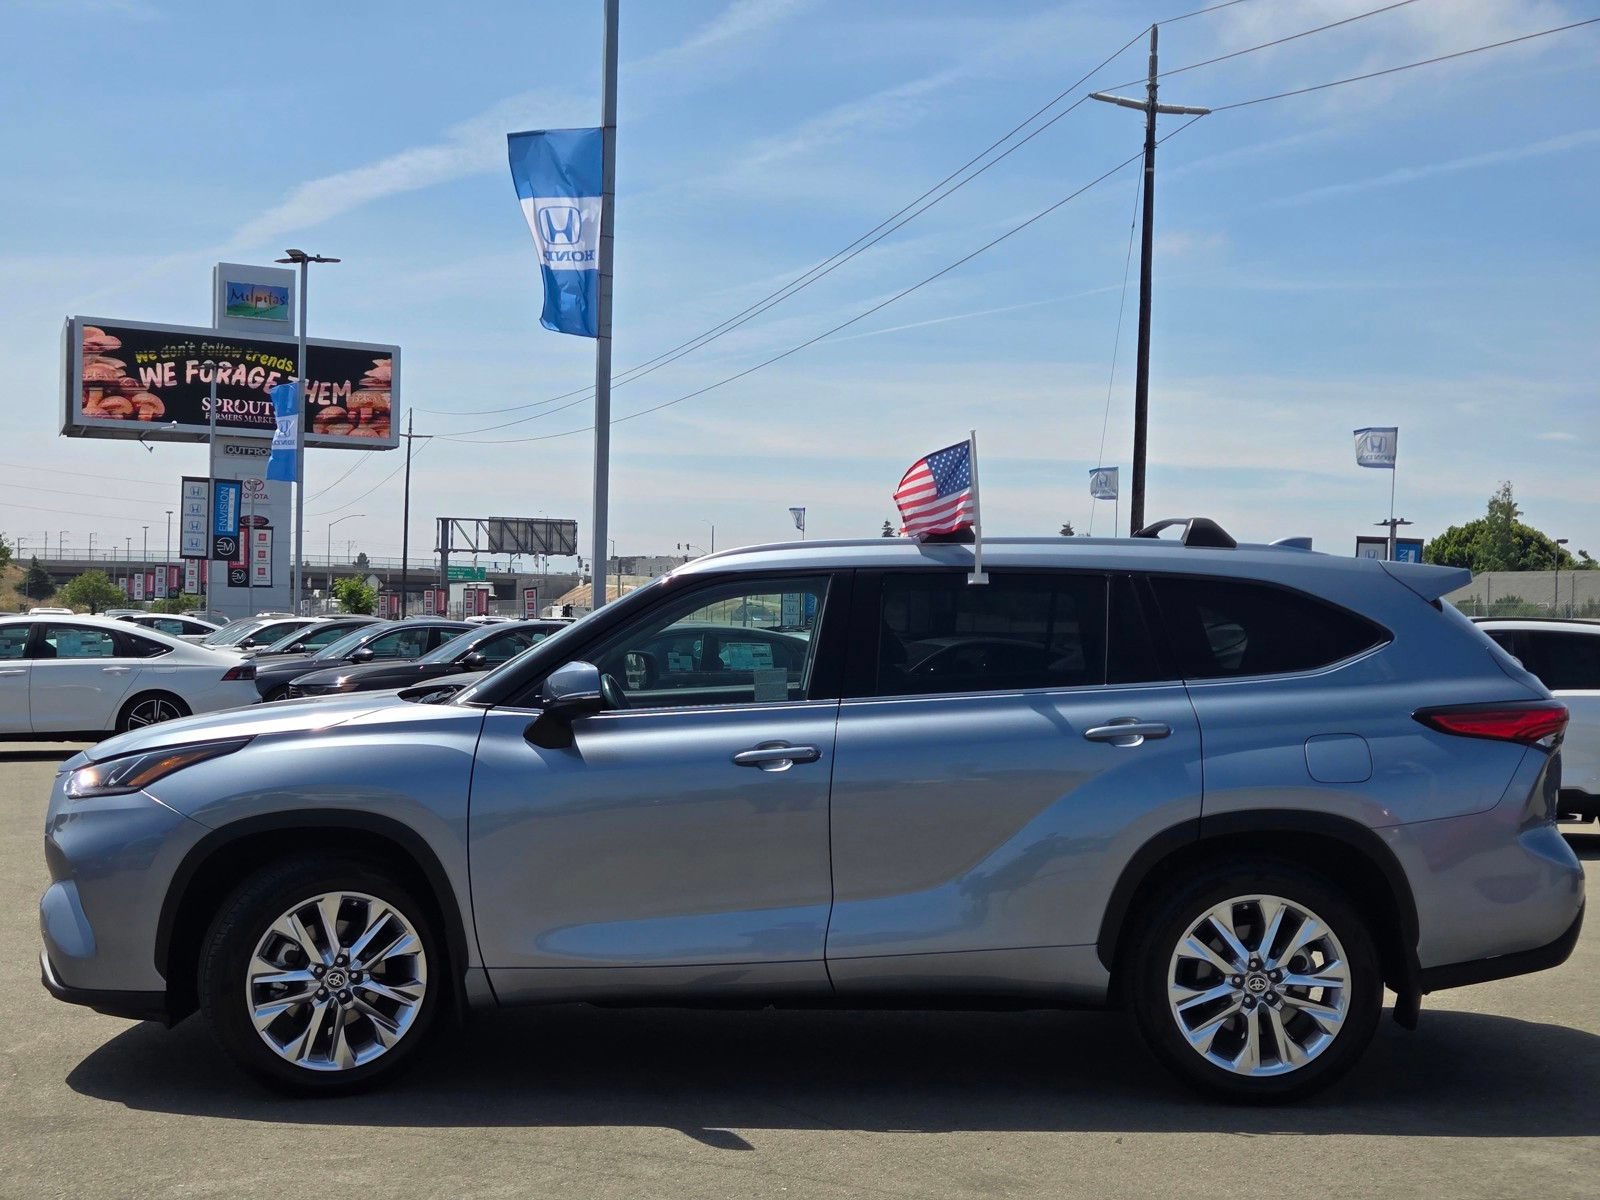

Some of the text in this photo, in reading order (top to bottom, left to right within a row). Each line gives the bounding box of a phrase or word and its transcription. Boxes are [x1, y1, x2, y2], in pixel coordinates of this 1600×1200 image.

[230, 287, 285, 307] Milpitas
[160, 341, 196, 358] don't
[201, 342, 243, 358] follow
[139, 362, 177, 389] WE
[186, 359, 281, 394] FORAGE
[201, 396, 274, 415] SPROUT
[205, 412, 274, 424] FRMERS MARKE
[228, 446, 273, 457] OUTFRON
[218, 486, 229, 532] ENVISION
